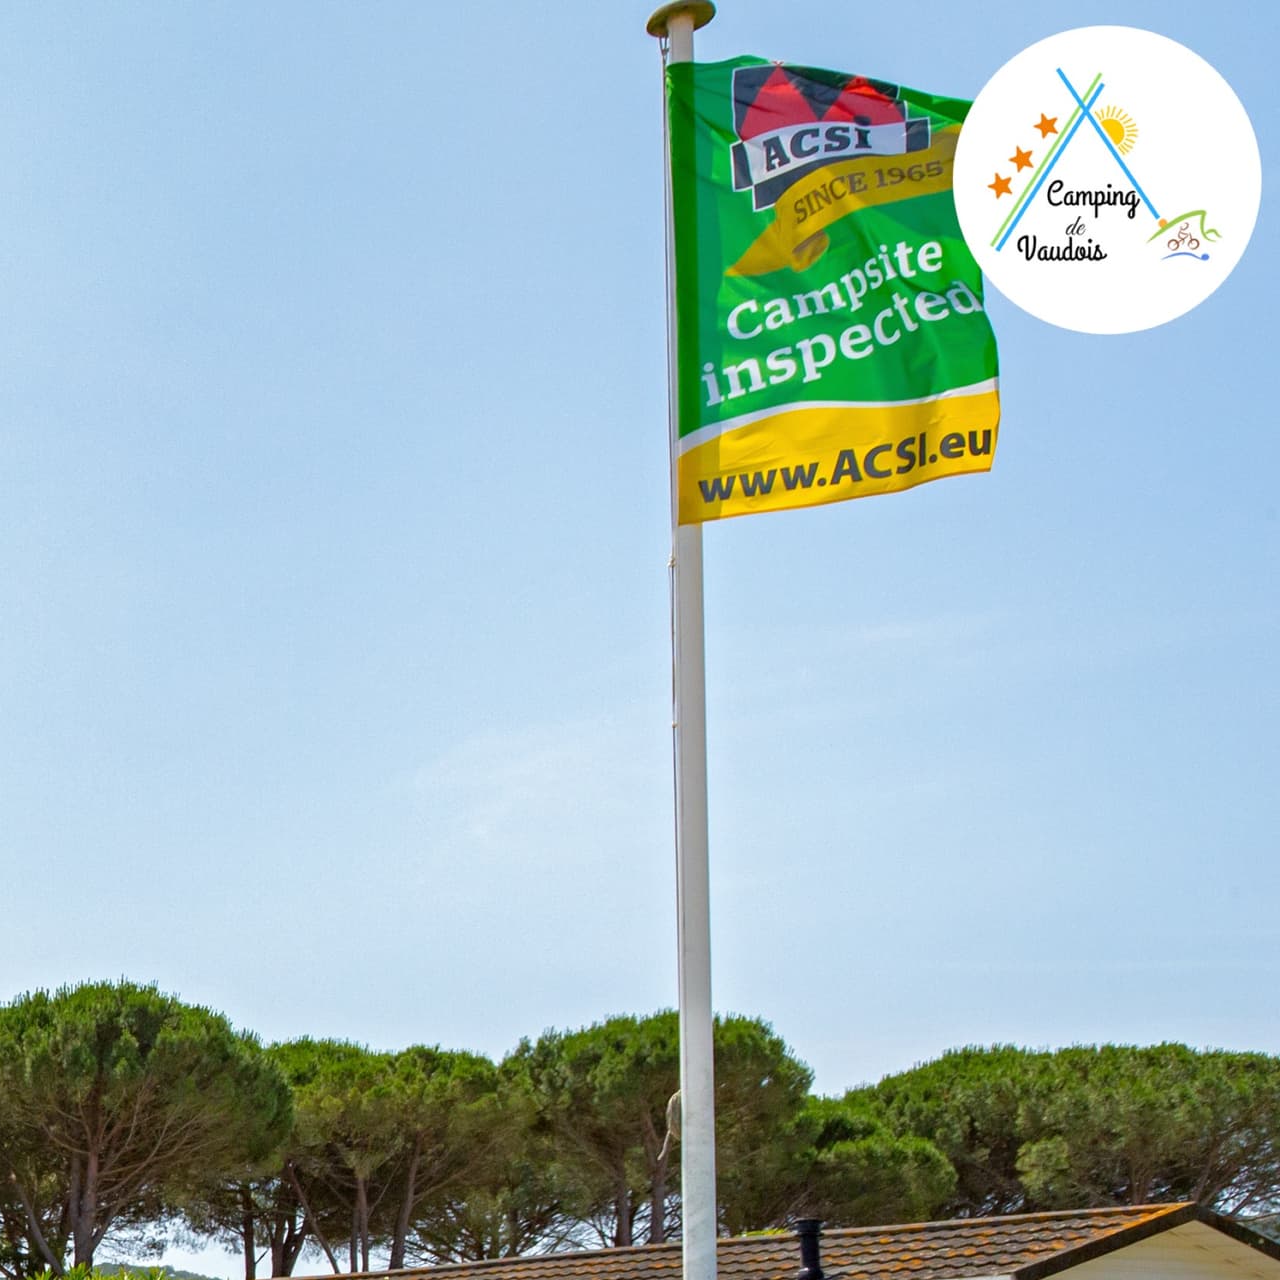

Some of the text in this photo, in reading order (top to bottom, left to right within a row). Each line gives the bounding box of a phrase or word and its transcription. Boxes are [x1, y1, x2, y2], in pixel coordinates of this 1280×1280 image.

[793, 160, 945, 225] SINCE 1965
[726, 240, 943, 340] Campsite
[701, 280, 983, 407] inspected
[698, 429, 992, 504] www.ACSI.eu
